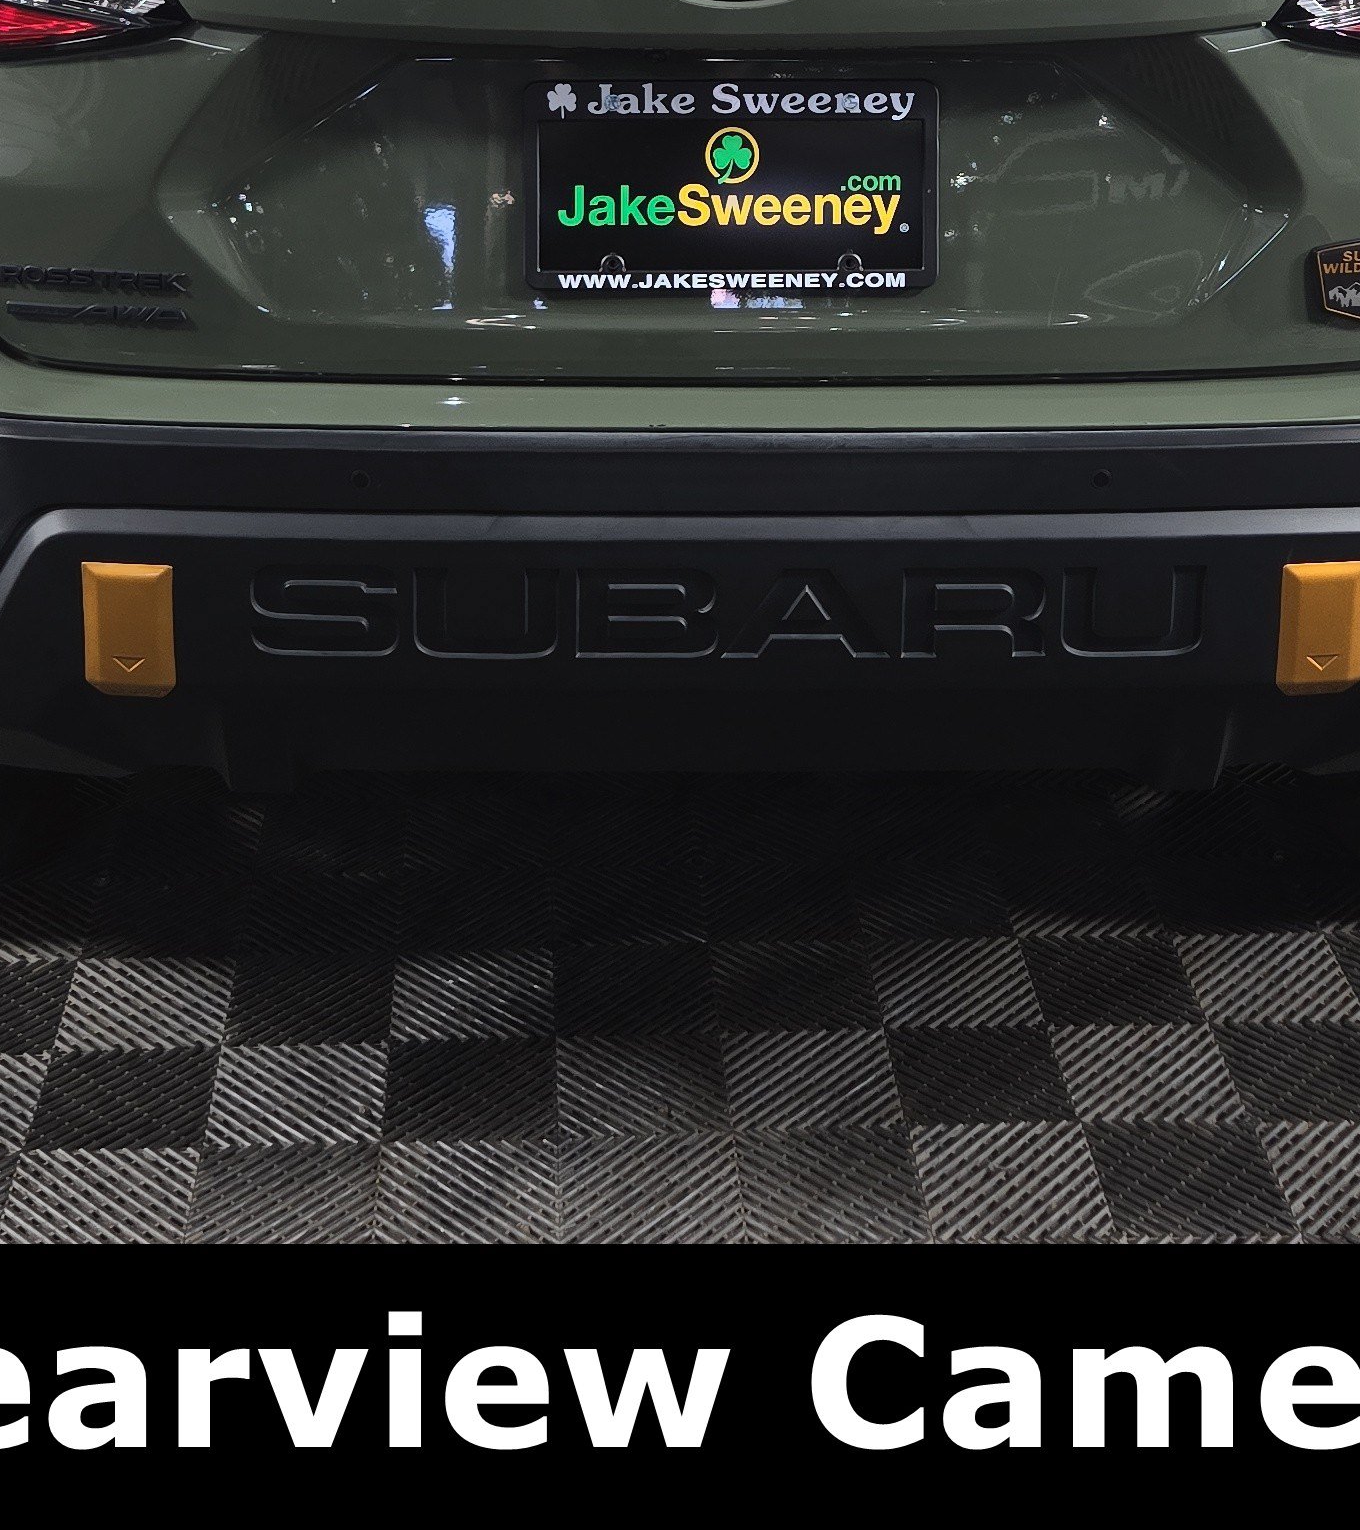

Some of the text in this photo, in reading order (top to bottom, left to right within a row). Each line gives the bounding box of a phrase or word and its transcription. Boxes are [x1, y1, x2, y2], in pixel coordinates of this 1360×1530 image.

[587, 82, 915, 120] Jake Sweeney
[558, 272, 906, 289] WWW.JAKESWEENEY.COM
[249, 565, 1210, 660] SUBARU
